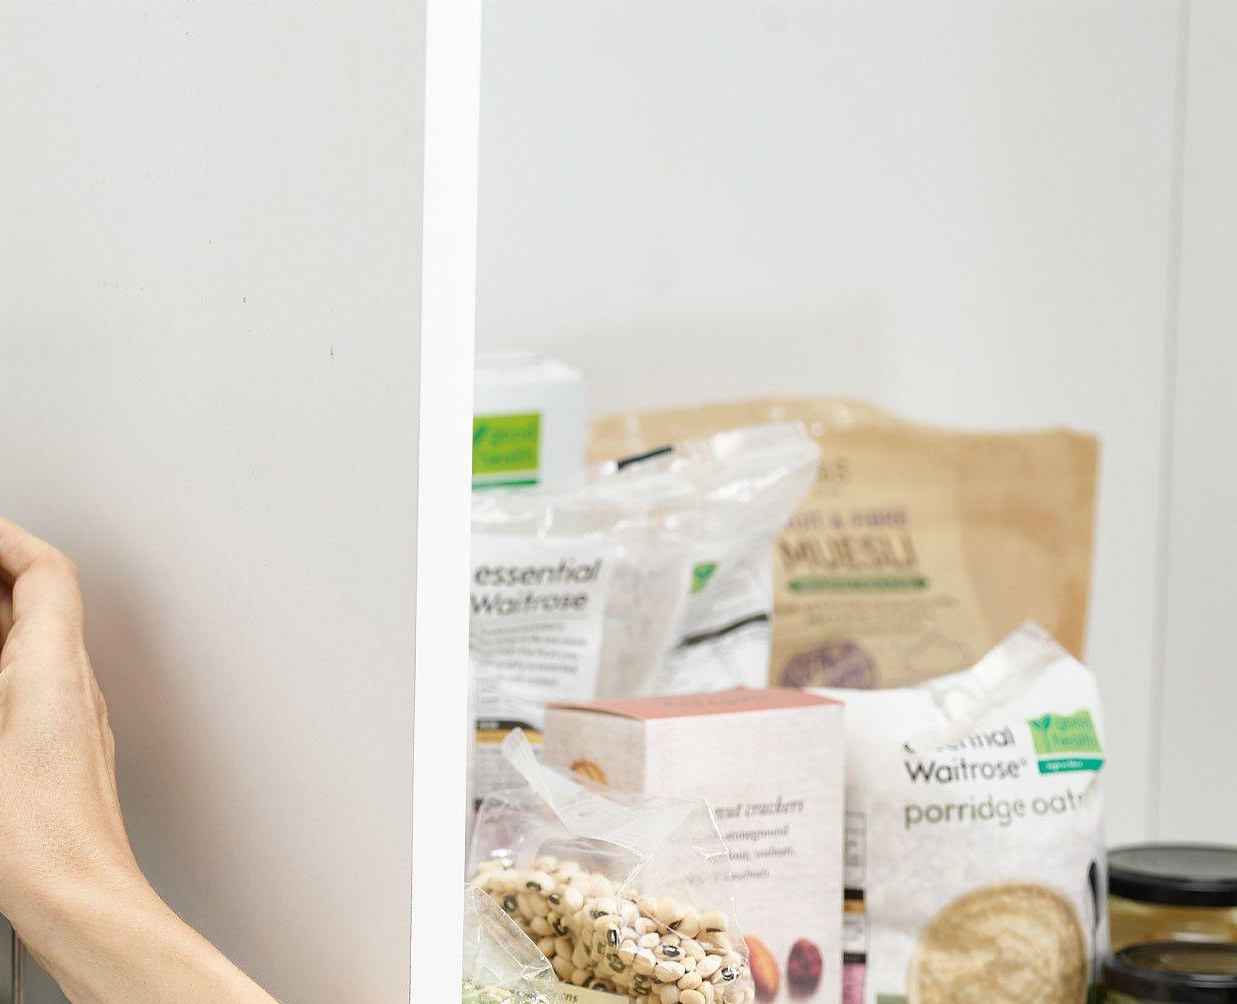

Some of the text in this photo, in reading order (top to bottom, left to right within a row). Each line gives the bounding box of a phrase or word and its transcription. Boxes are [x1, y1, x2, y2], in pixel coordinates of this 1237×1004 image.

[474, 557, 604, 586] essential
[903, 756, 1019, 784] Waitrose
[904, 795, 1027, 830] porridge
